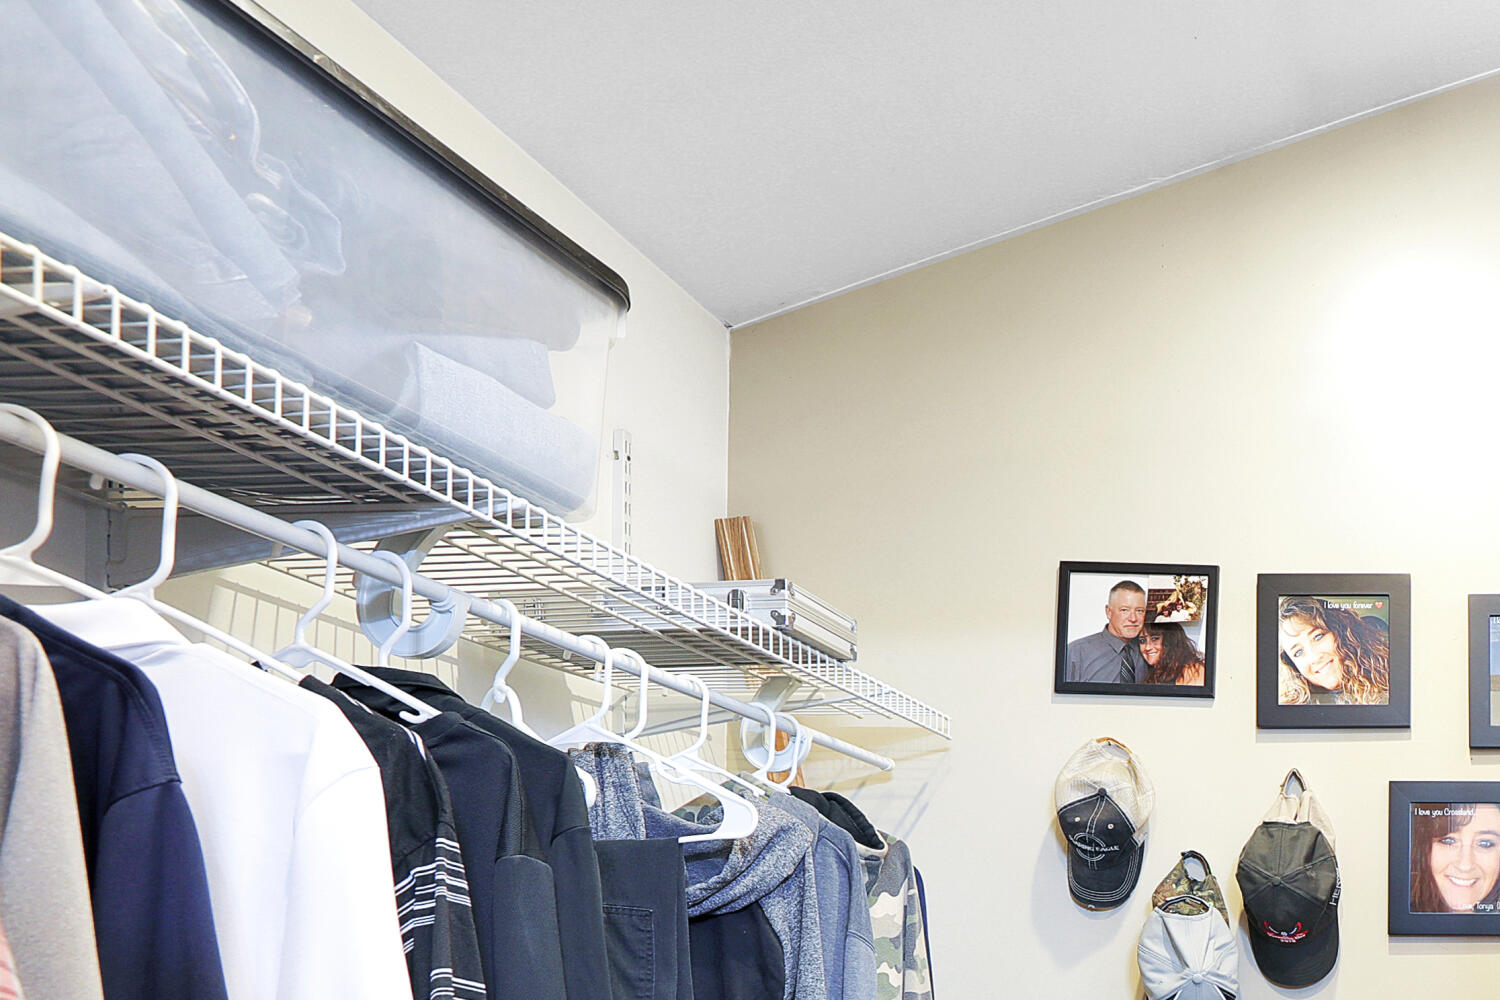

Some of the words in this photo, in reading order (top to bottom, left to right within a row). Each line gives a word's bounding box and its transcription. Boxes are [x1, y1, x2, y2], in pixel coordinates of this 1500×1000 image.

[1327, 601, 1339, 609] love
[1340, 603, 1351, 611] you
[1353, 601, 1373, 609] forever
[1418, 807, 1430, 816] love
[1431, 809, 1443, 818] you
[1476, 901, 1494, 912] Tonya
